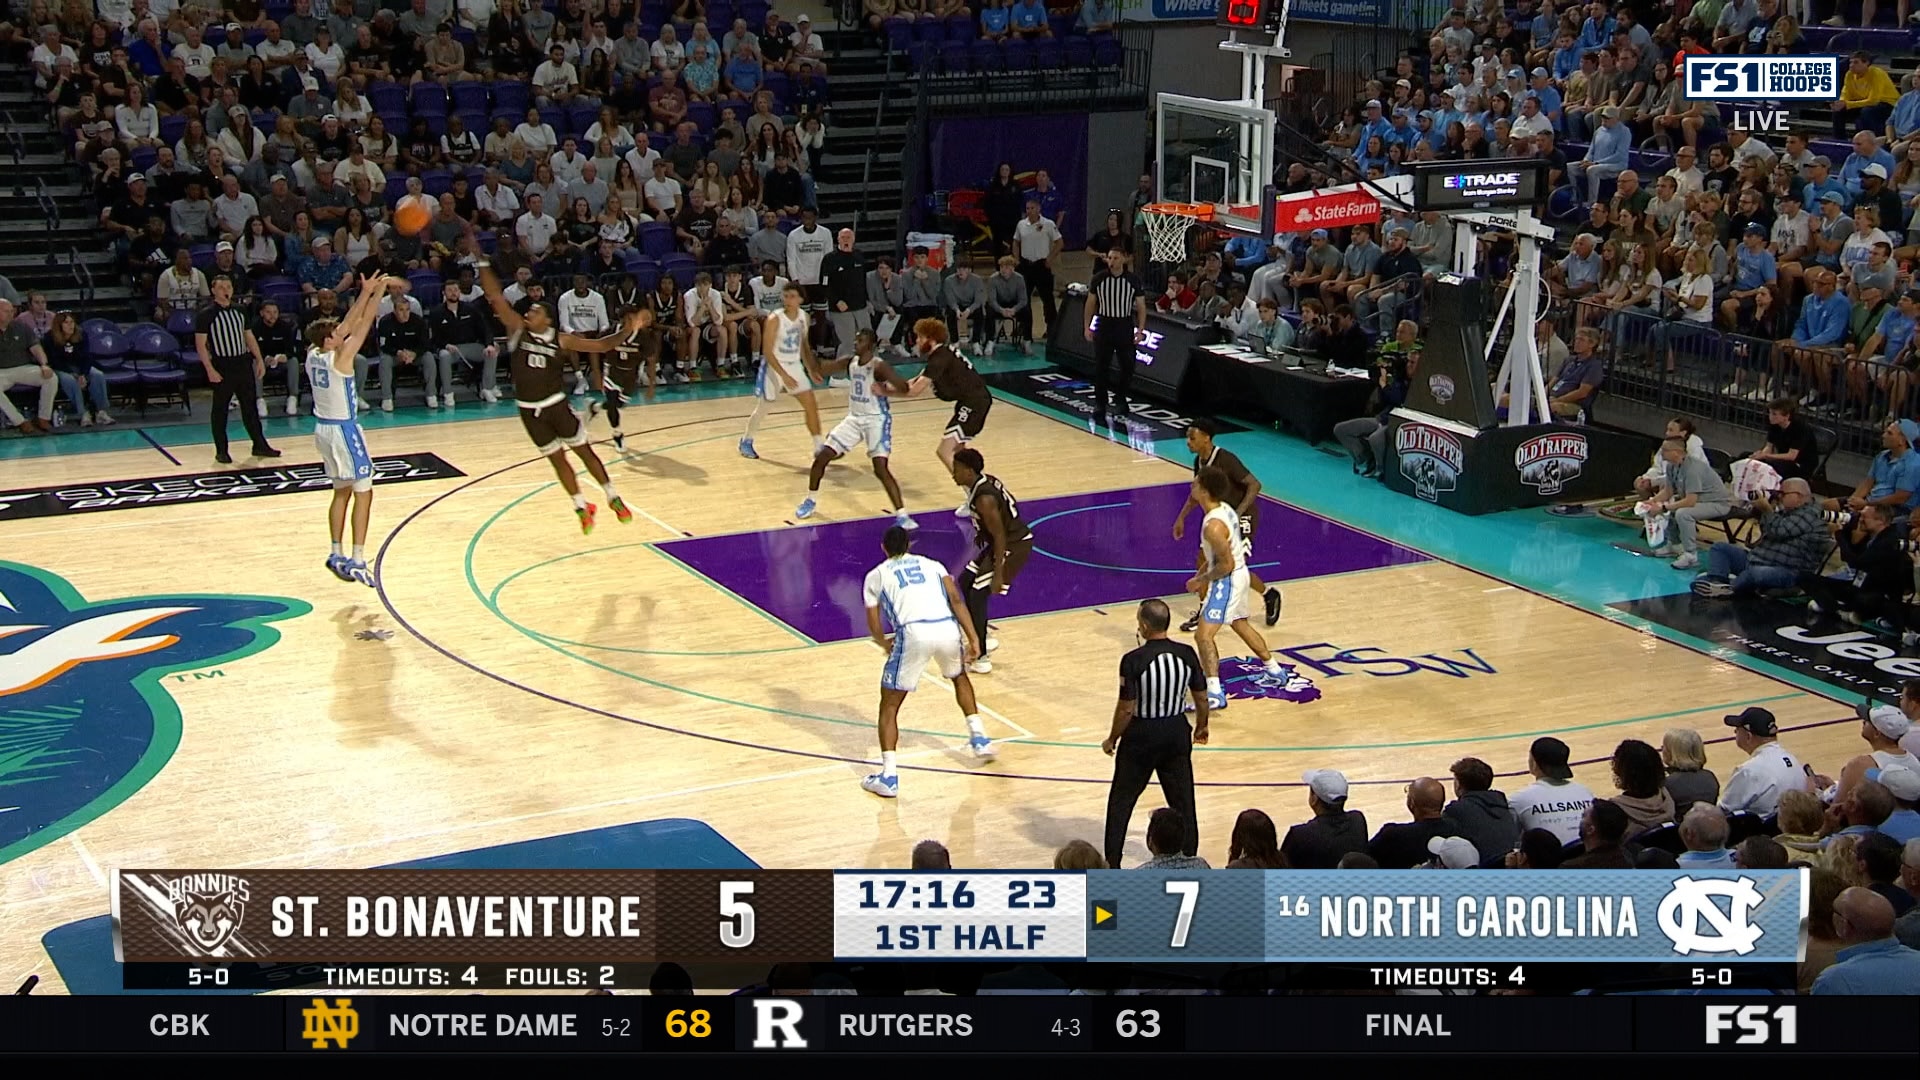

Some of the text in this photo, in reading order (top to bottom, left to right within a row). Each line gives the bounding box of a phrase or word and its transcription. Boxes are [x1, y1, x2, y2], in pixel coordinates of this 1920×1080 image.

[1488, 215, 1518, 229] porte
[311, 366, 330, 389] 13
[55, 460, 412, 501] SKECHES
[69, 468, 438, 510] BASKETBLL
[893, 566, 927, 589] 15
[1270, 642, 1498, 678] FSW
[1813, 664, 1874, 686] ONLY
[1783, 757, 1793, 768] B
[1531, 800, 1592, 816] ALLSAINT
